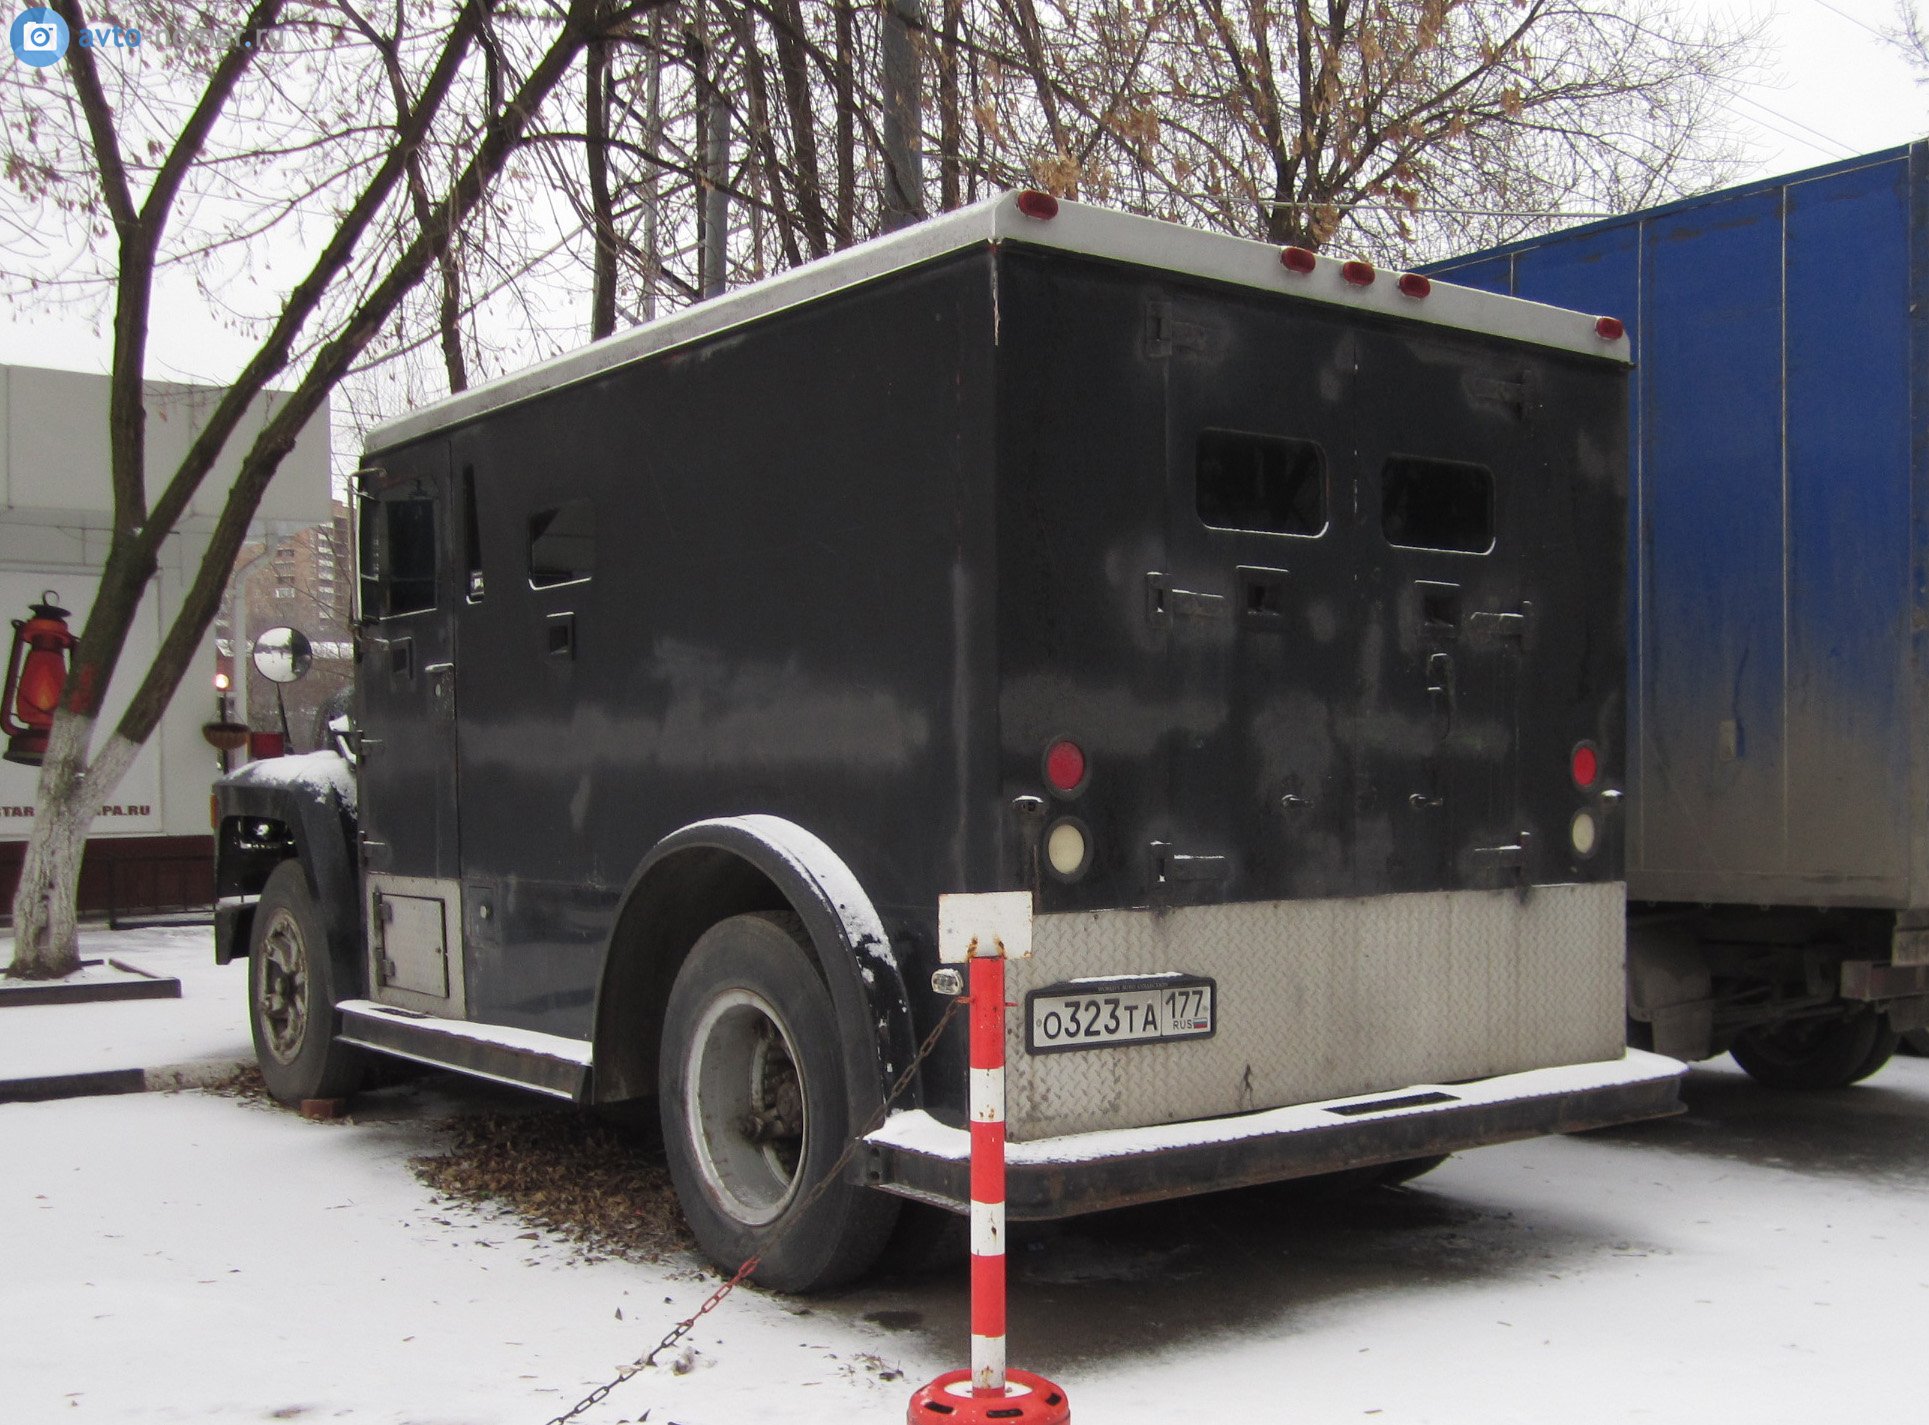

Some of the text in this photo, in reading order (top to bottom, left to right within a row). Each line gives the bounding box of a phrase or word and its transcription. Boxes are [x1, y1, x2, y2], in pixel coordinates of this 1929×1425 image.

[1043, 990, 1204, 1040] O323TA 177
[1172, 1018, 1193, 1030] RUS
